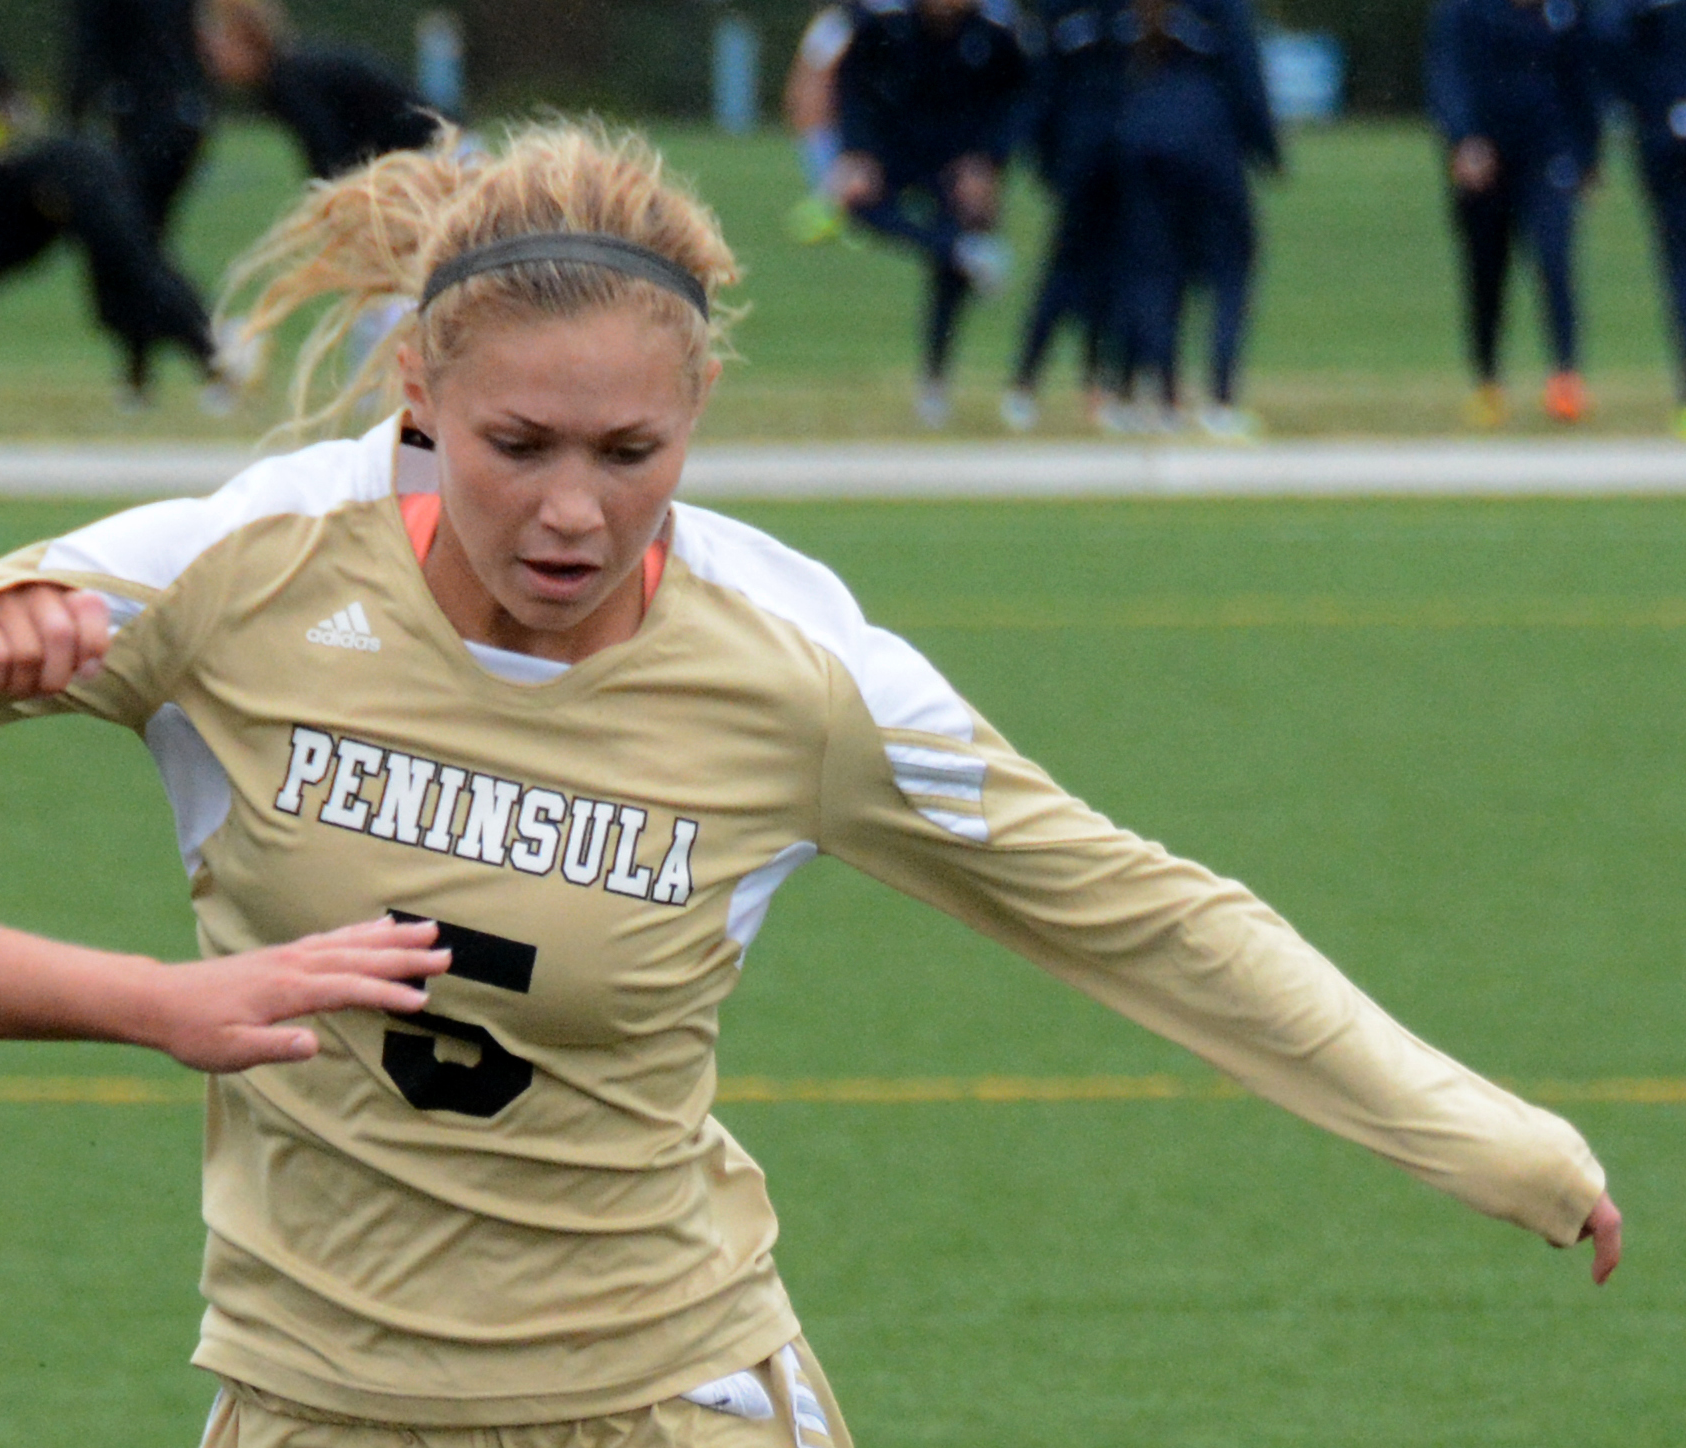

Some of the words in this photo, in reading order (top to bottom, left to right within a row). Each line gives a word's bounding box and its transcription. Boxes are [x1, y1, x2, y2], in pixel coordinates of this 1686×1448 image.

[306, 627, 381, 652] adidas
[274, 723, 698, 906] PENINSULA
[383, 908, 537, 1118] 5
